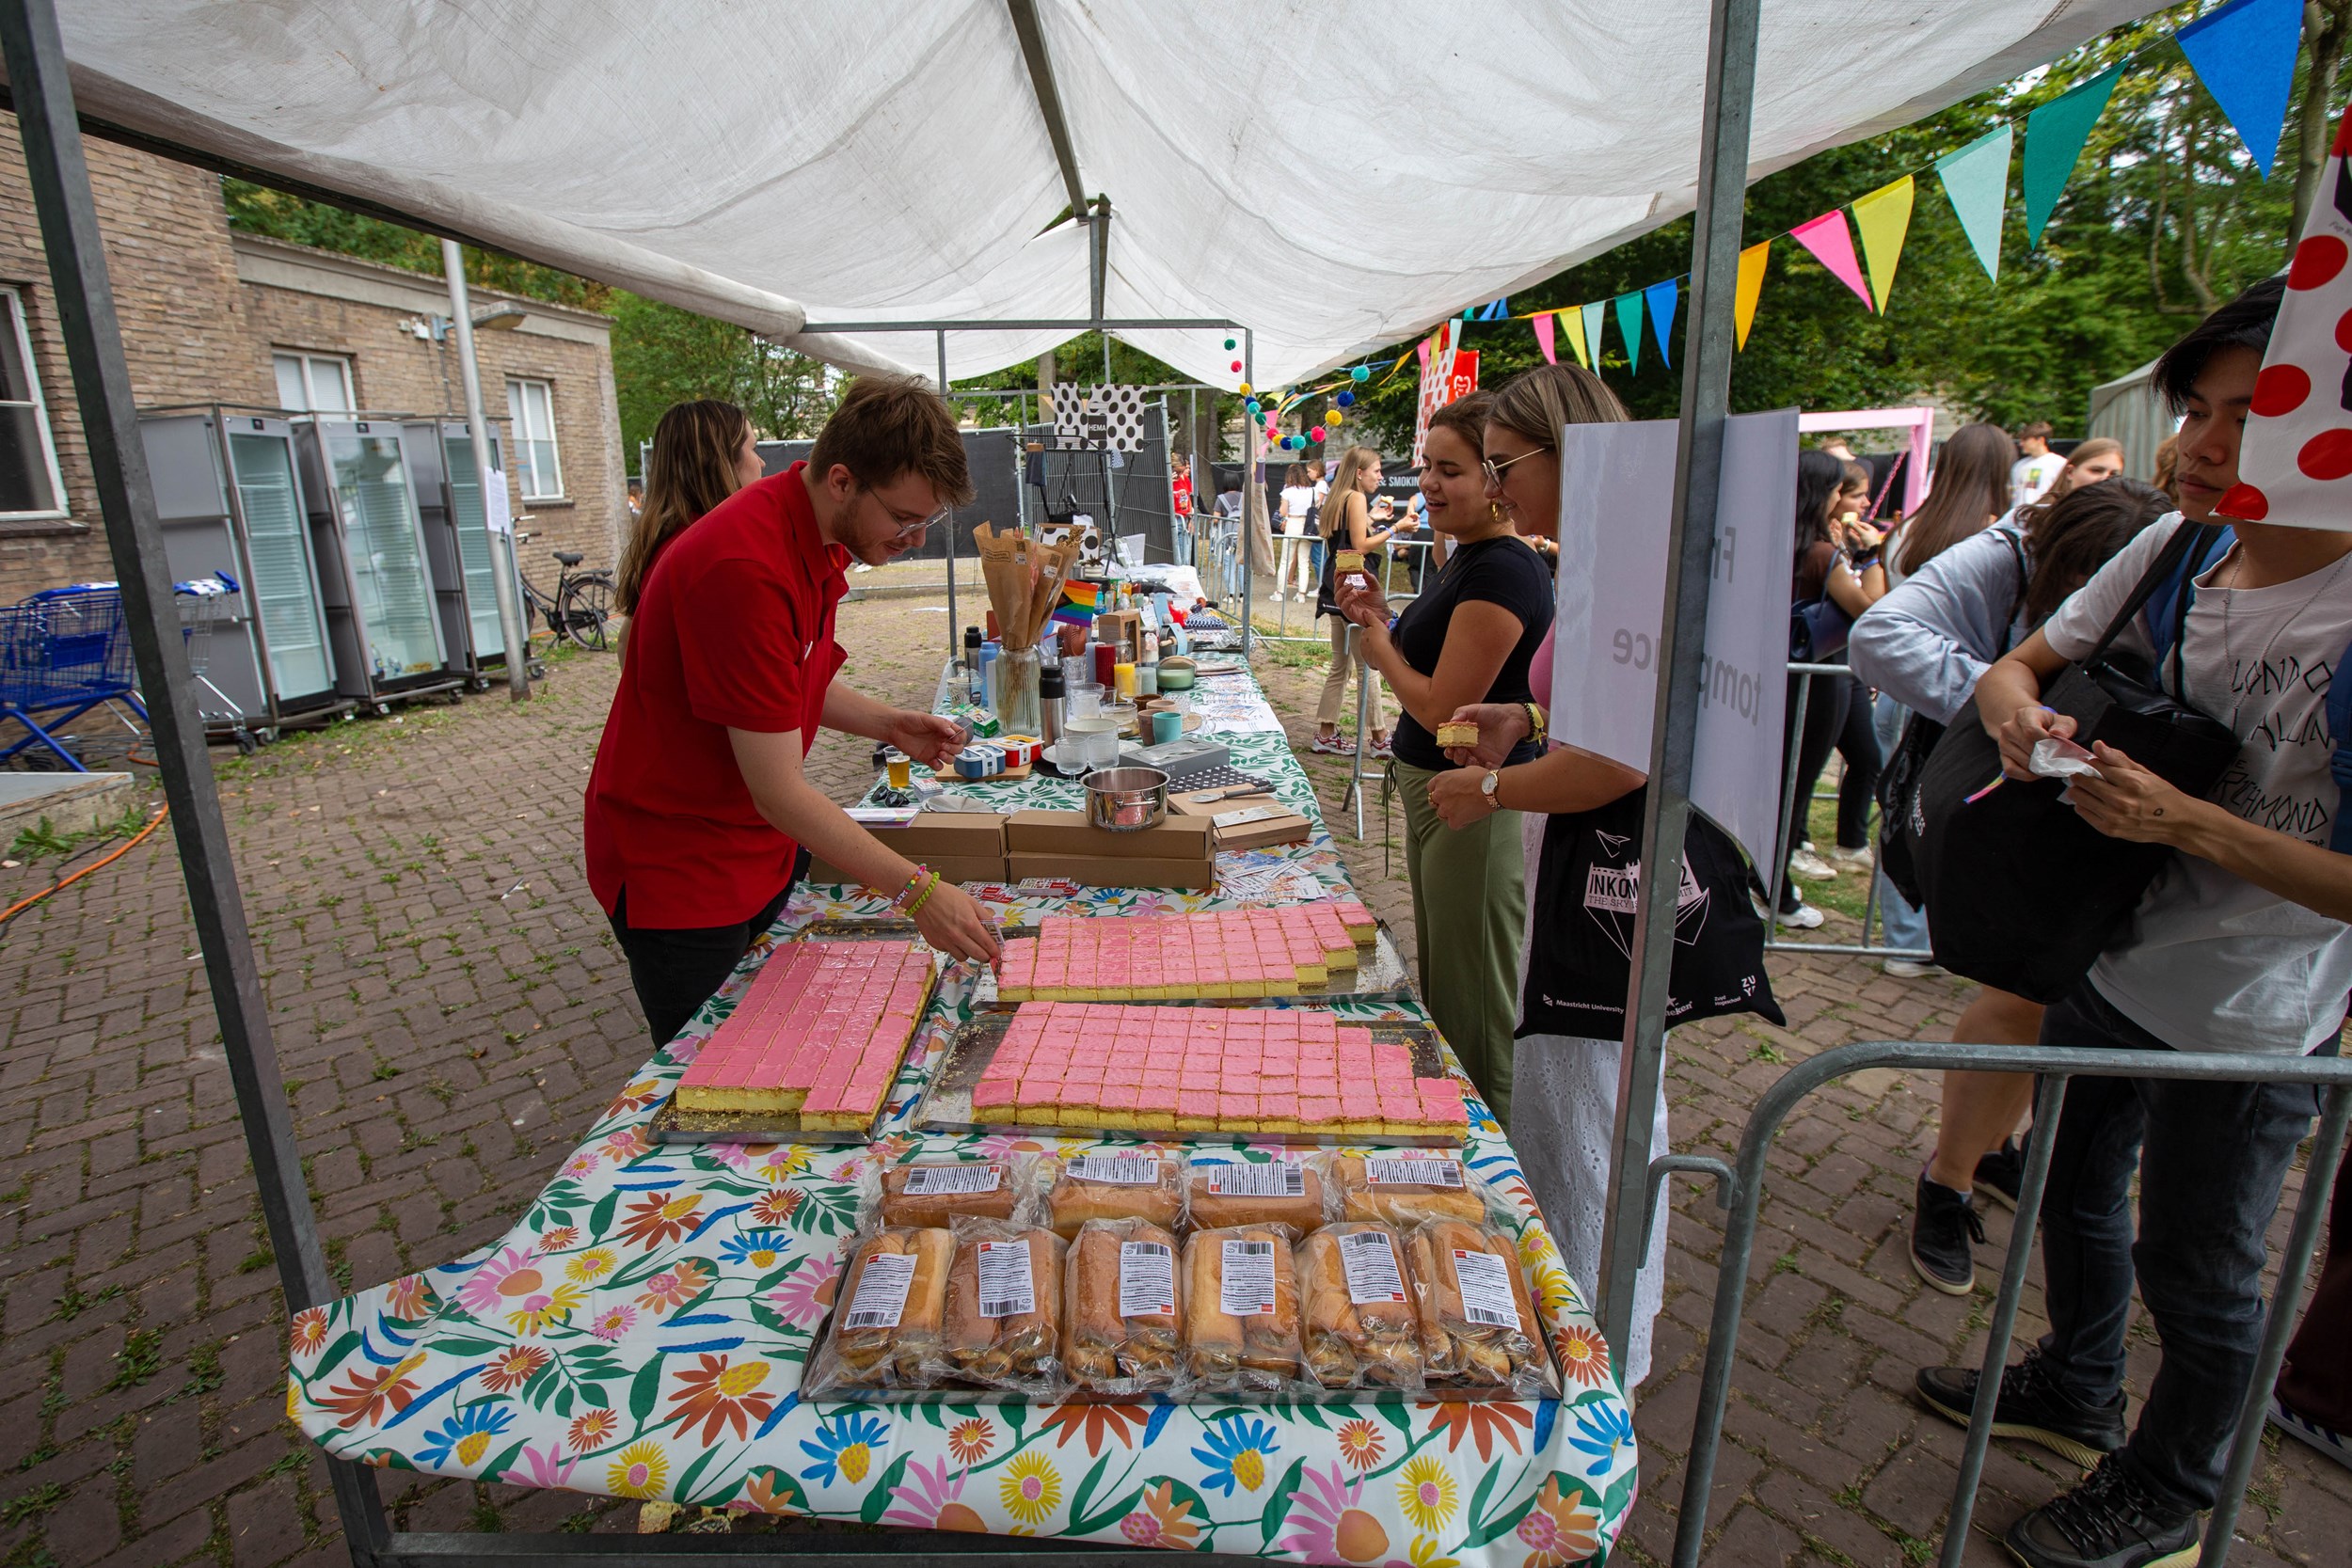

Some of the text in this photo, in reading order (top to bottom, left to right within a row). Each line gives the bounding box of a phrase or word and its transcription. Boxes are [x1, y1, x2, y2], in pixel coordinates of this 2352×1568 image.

[1088, 423, 1107, 432] HEMA
[1388, 475, 1420, 487] SMOKIN
[2231, 656, 2333, 696] LONDO
[1589, 895, 1608, 906] THE
[1610, 898, 1629, 909] SKY
[1677, 887, 1693, 899] MIT
[1740, 974, 1756, 988] ZU
[1555, 999, 1625, 1015] Maastricht University
[1665, 1001, 1692, 1017] neken
